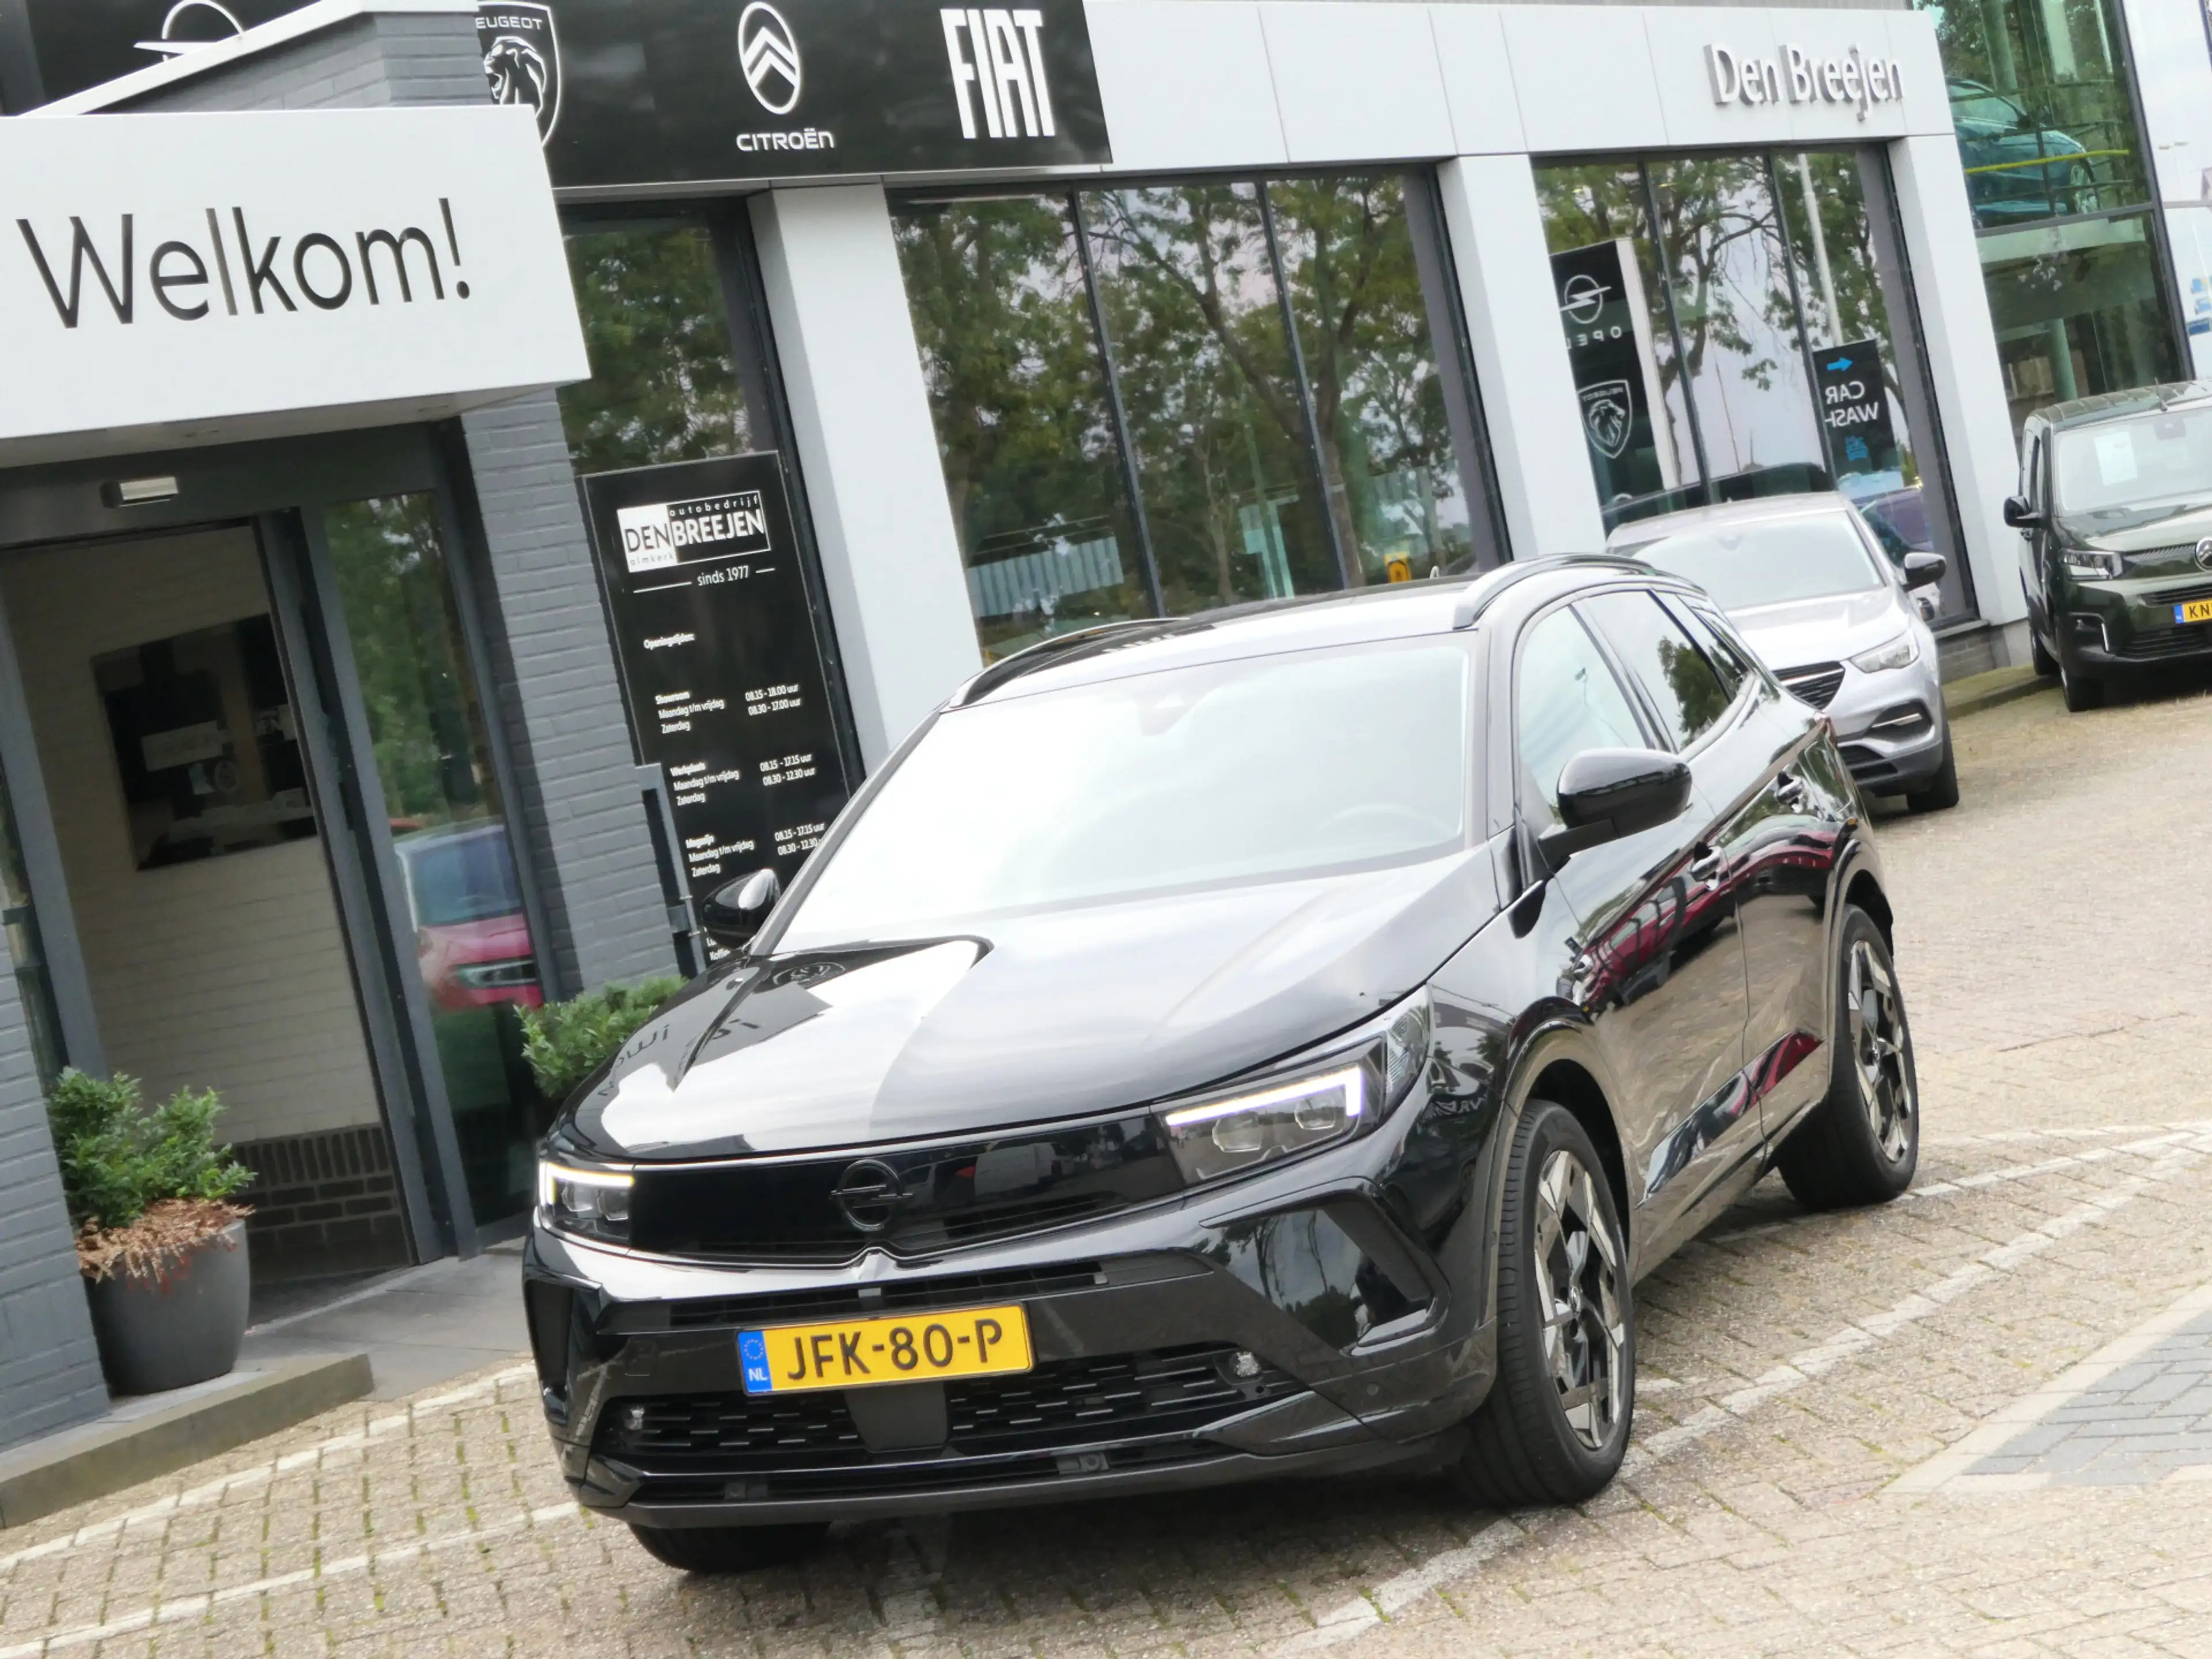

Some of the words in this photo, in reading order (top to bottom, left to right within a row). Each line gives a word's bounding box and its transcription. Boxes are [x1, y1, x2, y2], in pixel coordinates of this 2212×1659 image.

[475, 16, 543, 30] EUGEOT
[940, 9, 1055, 139] FIAT
[1703, 44, 1782, 105] Den
[1779, 42, 1904, 122] Breejen
[16, 198, 469, 329] Welkom!
[669, 495, 758, 517] autobedrijf
[697, 571, 725, 586] sinds
[726, 565, 749, 582] 1977
[2189, 603, 2212, 618] KN
[787, 1319, 1002, 1380] JFK-80-P
[748, 1368, 768, 1381] NL
